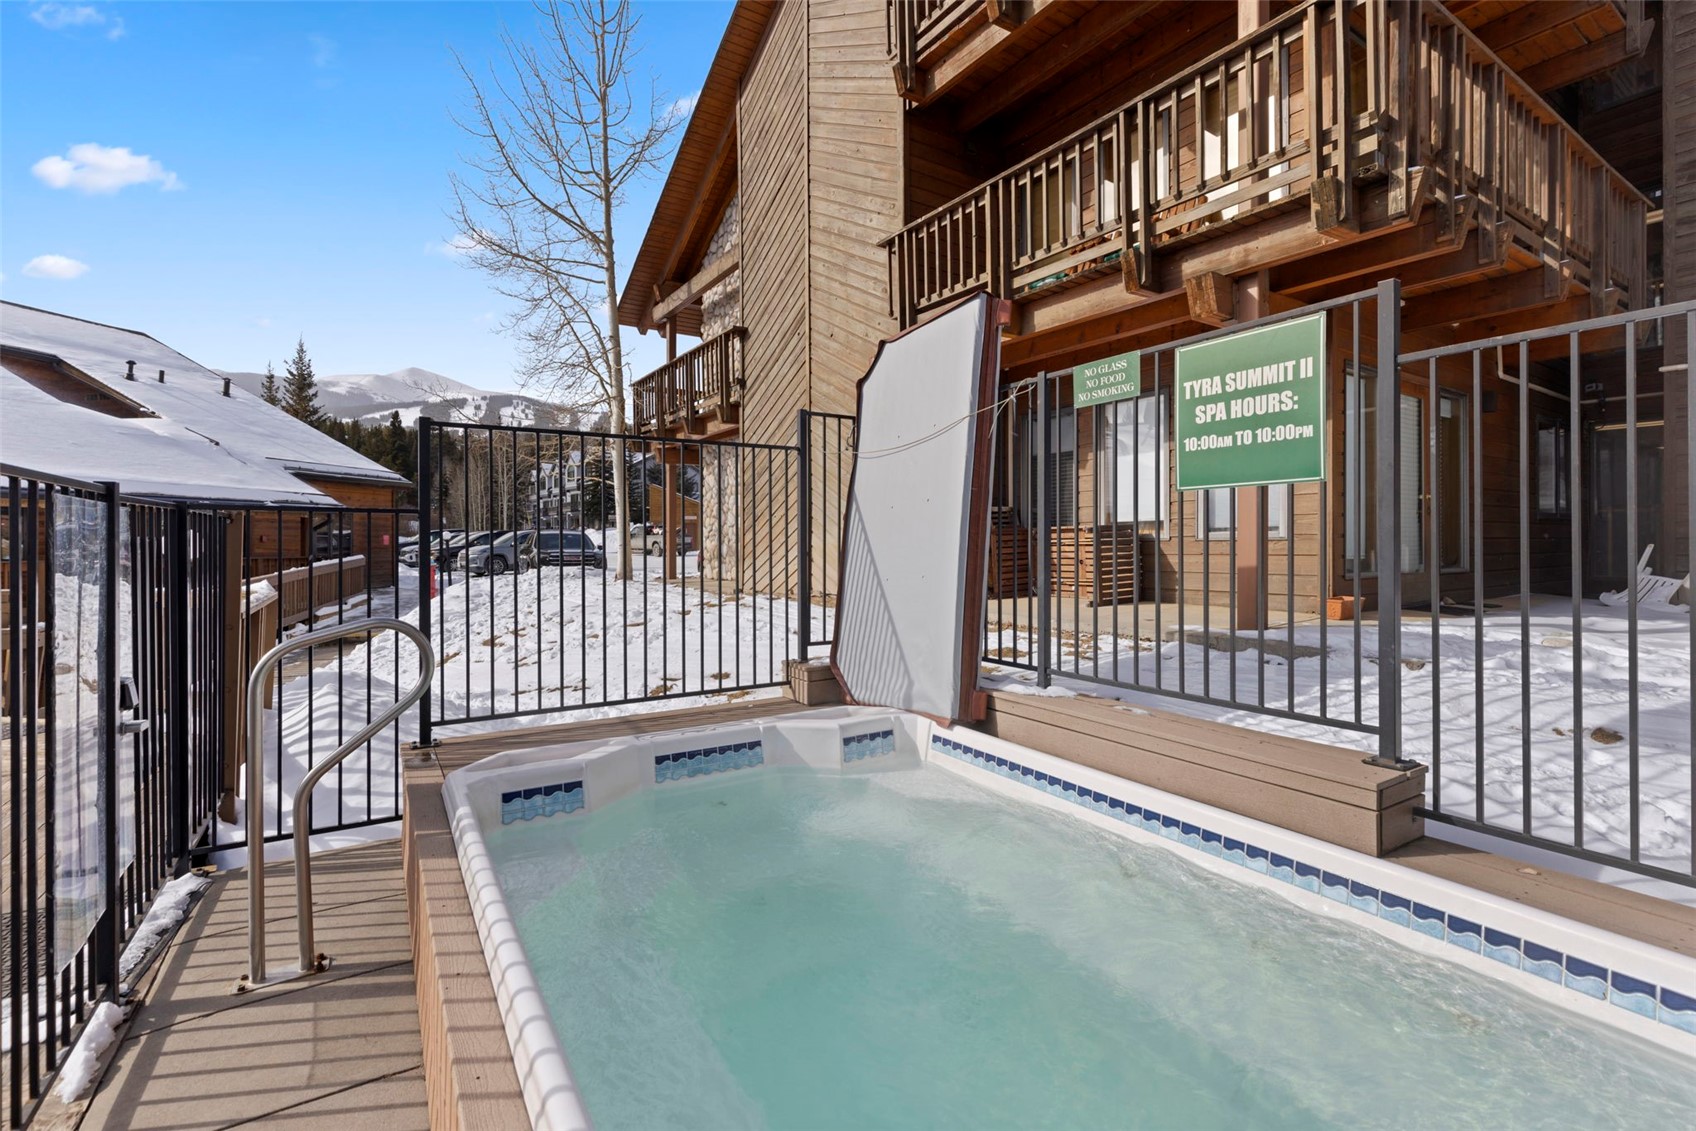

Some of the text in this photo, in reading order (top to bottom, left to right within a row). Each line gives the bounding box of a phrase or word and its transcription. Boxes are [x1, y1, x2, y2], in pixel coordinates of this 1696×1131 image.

[1084, 360, 1127, 378] NO GLASS
[1086, 372, 1126, 388] NO FOOD
[1184, 356, 1313, 400] TYRA SUMMIT II
[1078, 382, 1134, 402] NO SMOKING
[1195, 390, 1298, 424] SPA HOURS:
[1184, 424, 1314, 452] 10:00AM TO 10:00PM
